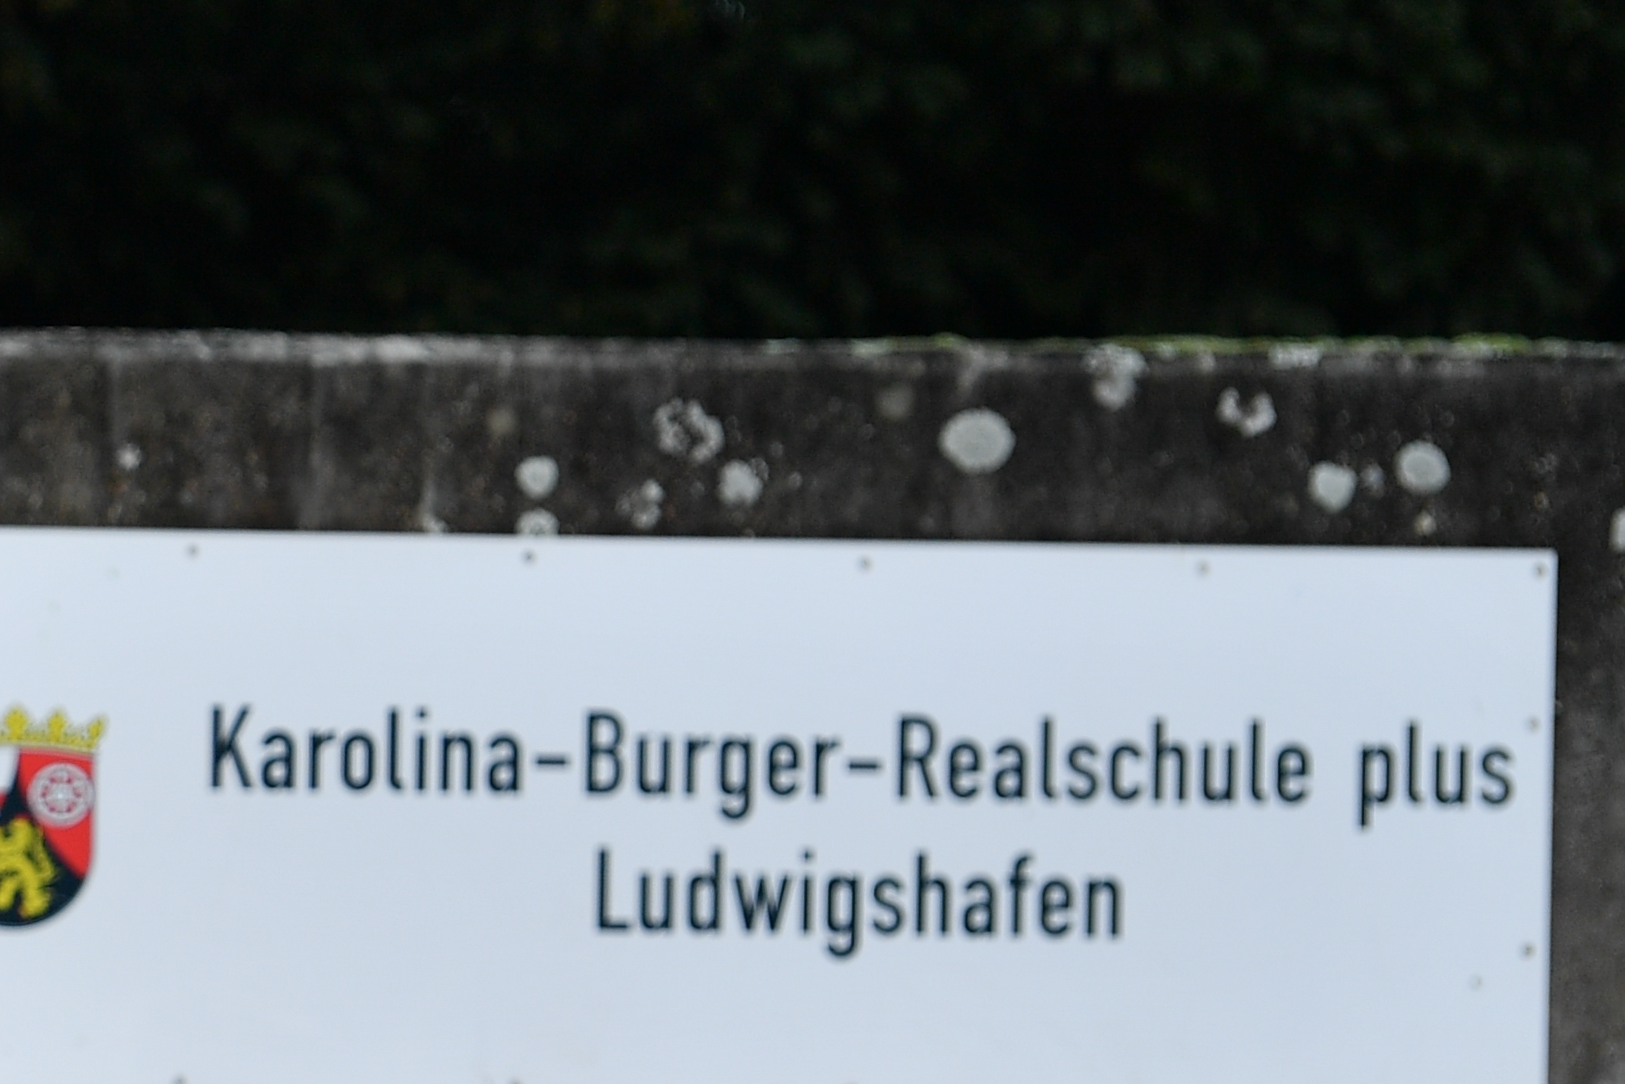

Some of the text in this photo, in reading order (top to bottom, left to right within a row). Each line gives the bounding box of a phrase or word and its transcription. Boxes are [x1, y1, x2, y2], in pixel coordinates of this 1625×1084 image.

[208, 703, 1515, 832] Karolina-Burger-Realschule plus
[594, 845, 1124, 961] Ludwigshafen
